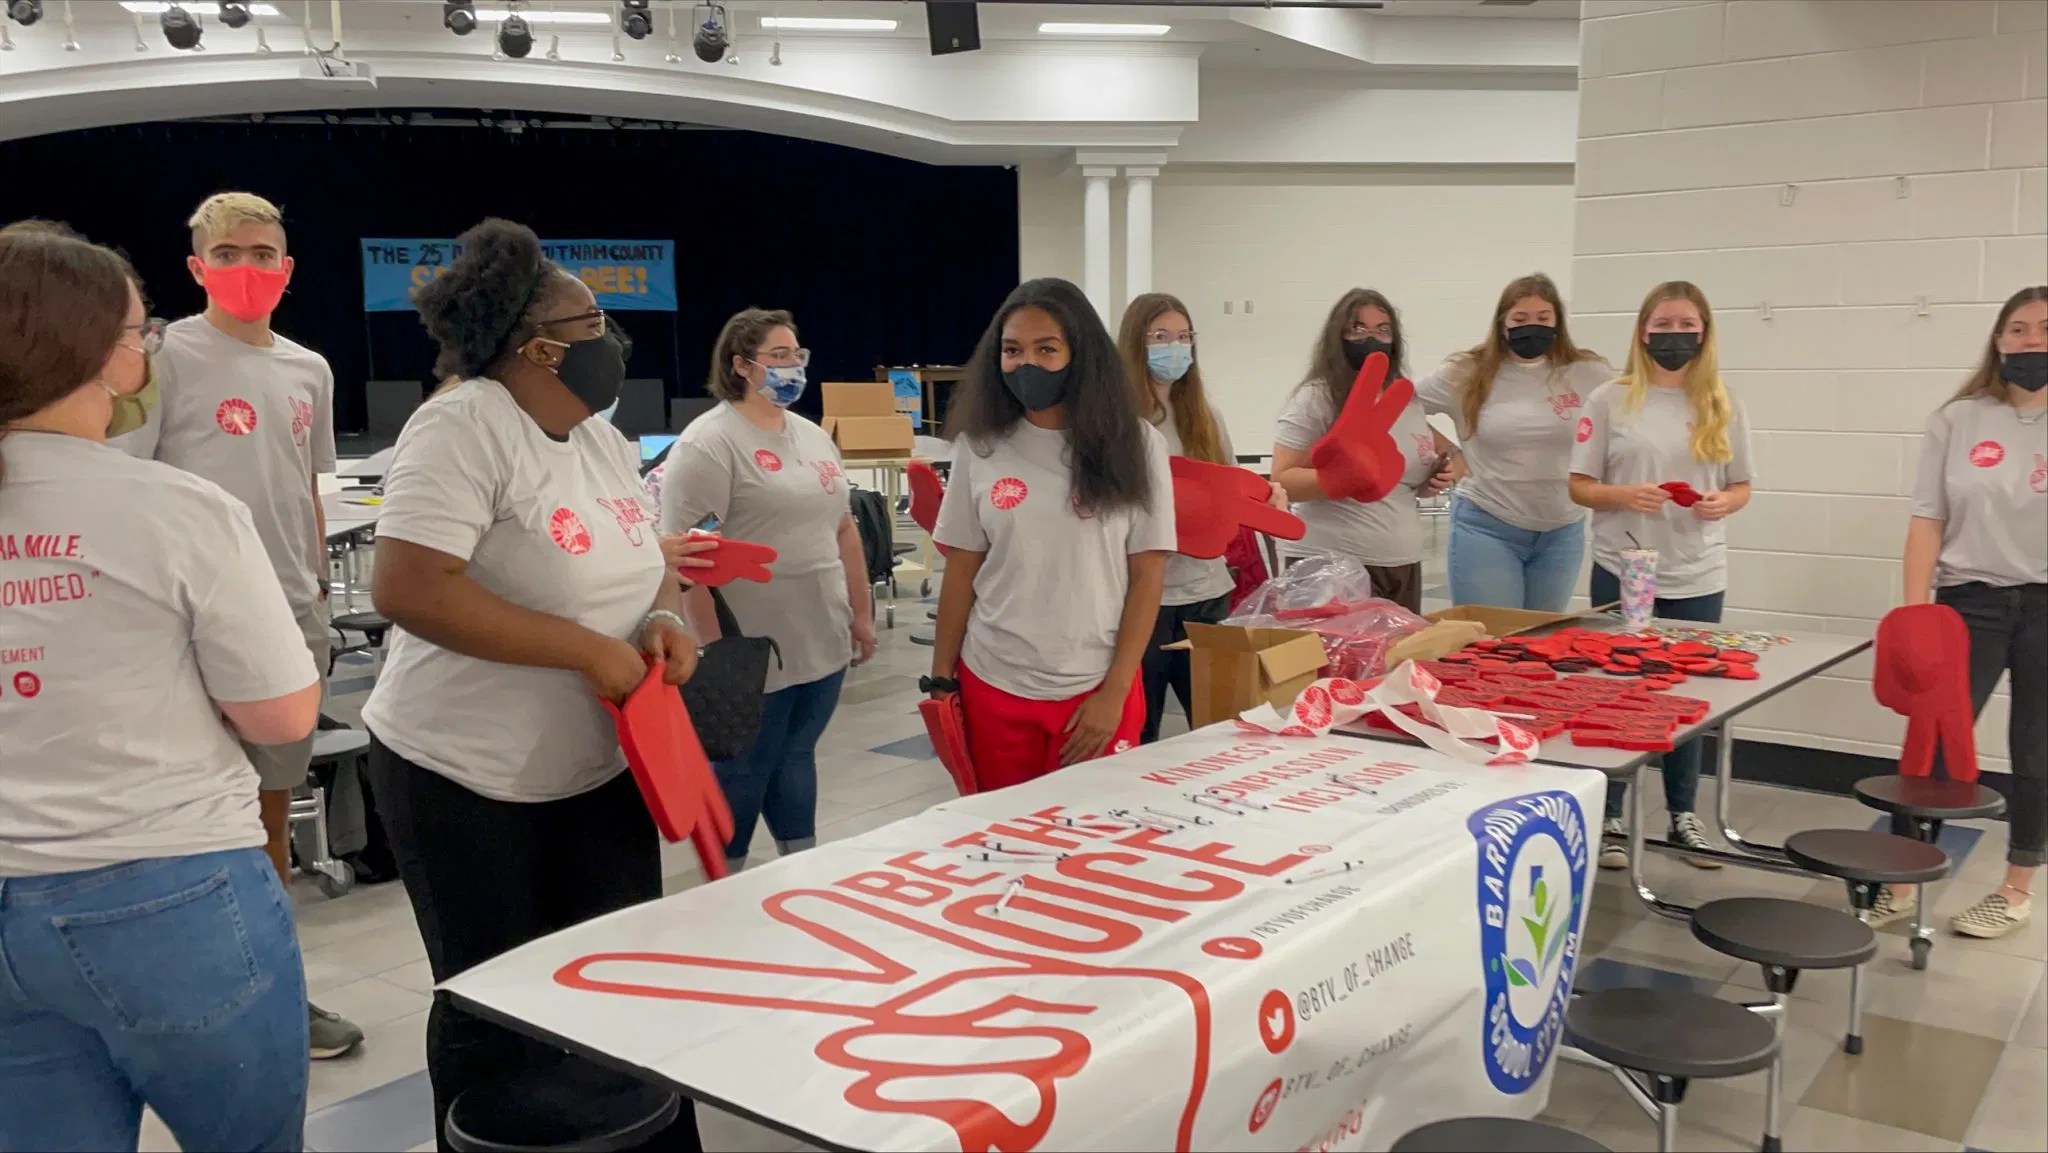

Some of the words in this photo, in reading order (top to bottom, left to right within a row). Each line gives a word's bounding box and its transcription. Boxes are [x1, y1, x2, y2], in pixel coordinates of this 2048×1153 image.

[367, 245, 410, 265] THE
[1204, 746, 1366, 806] OMPASSION
[833, 851, 1006, 907] BE
[1297, 931, 1417, 1021] @BTV_OF_CHANGE
